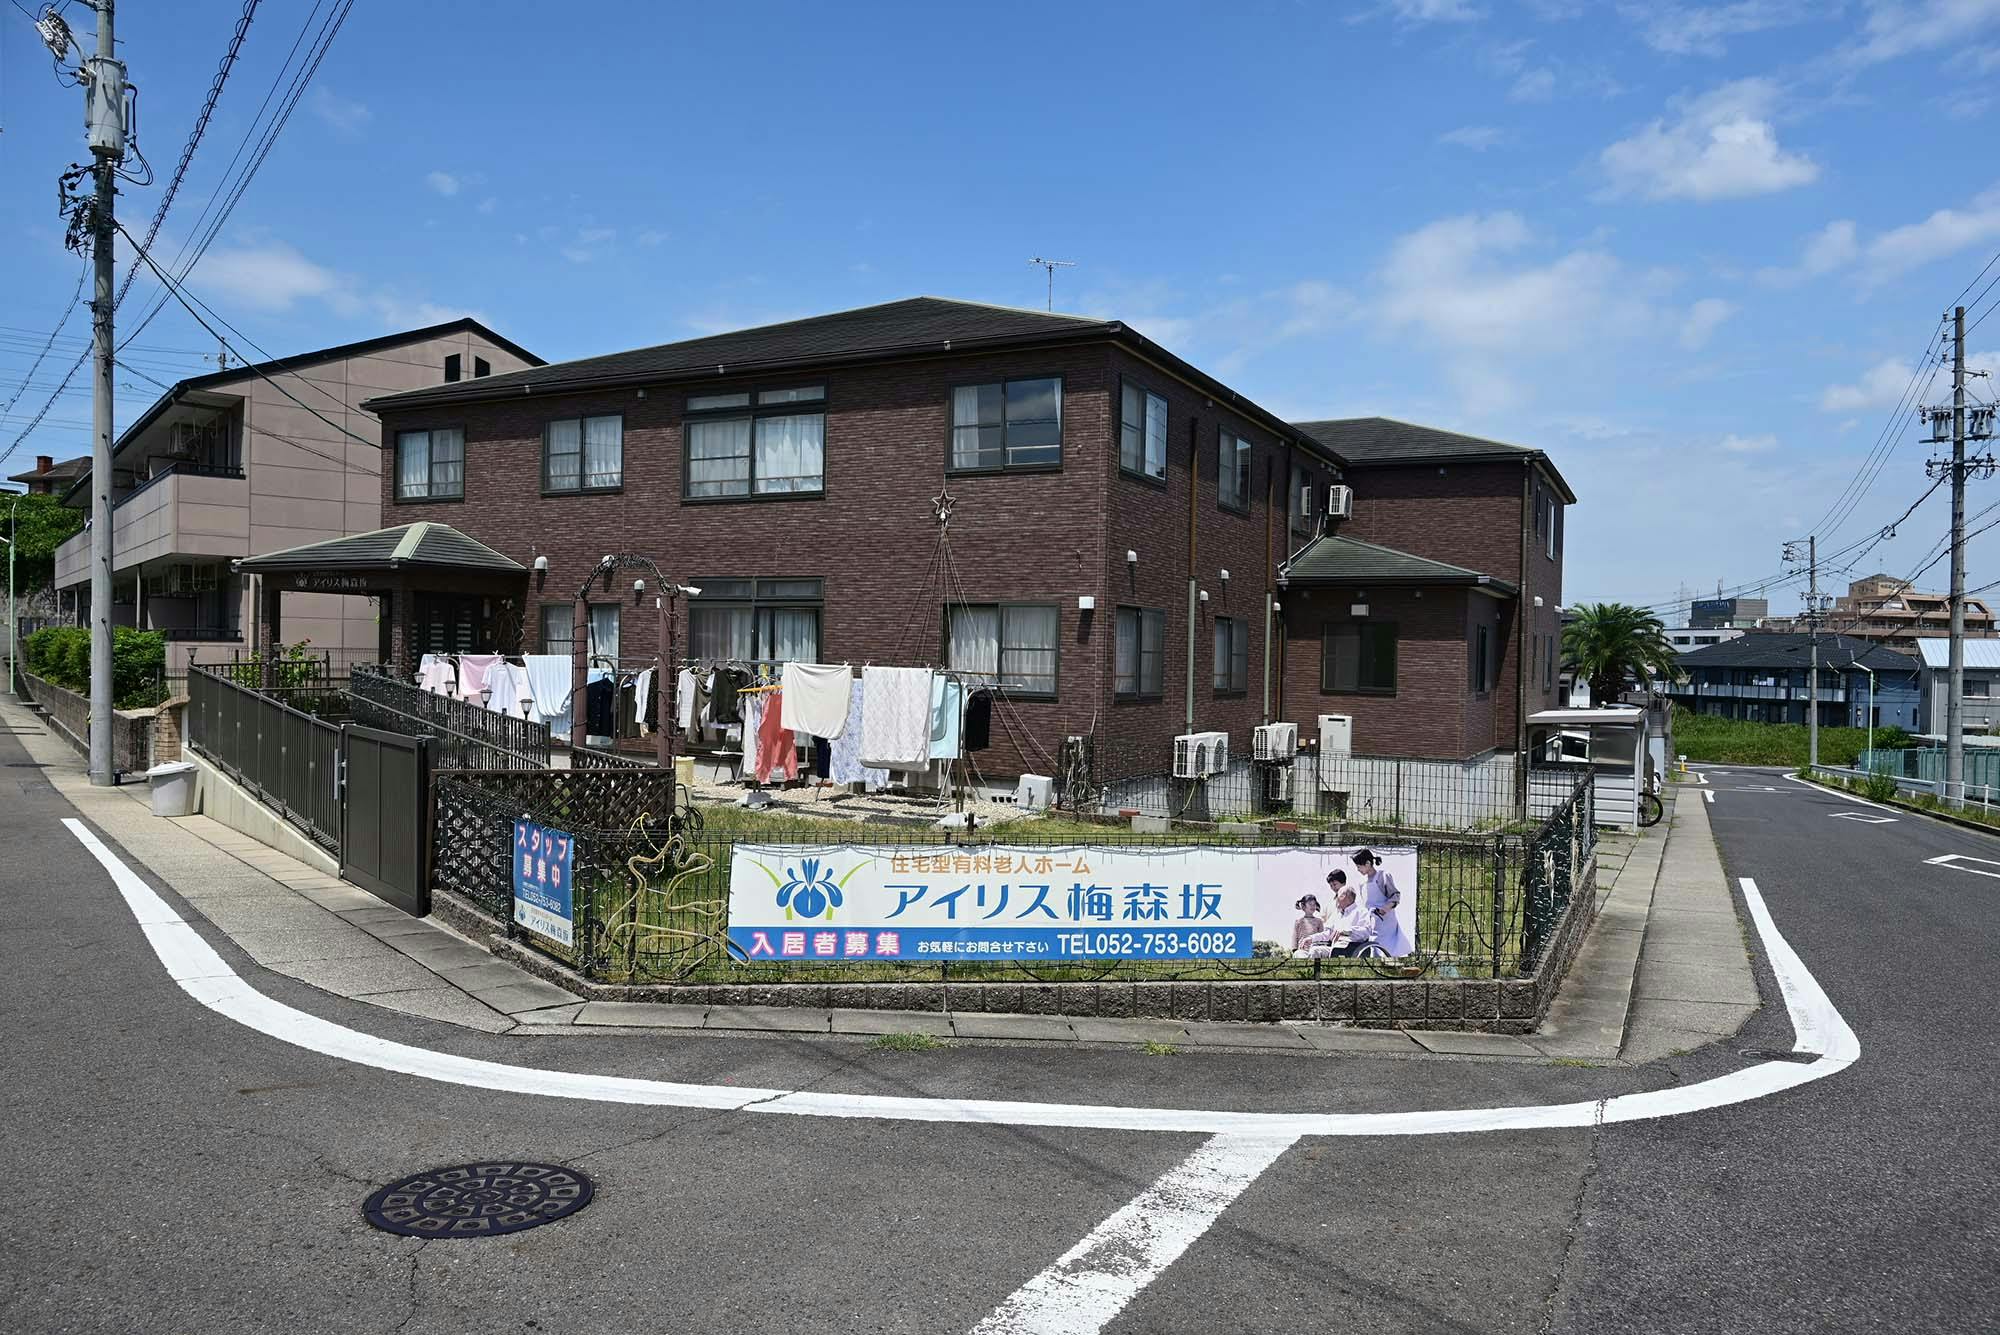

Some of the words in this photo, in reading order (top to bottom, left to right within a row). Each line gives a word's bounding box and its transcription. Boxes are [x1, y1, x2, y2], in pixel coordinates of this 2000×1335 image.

[518, 825, 567, 861] スタッフ
[523, 854, 560, 888] 募集中
[890, 855, 1091, 875] 住宅型有料老人ホーム
[884, 883, 1223, 921] アイリス梅森坂
[752, 932, 900, 956] 入居者募集
[917, 941, 1049, 953] お気軽にお問合せ下さい
[1057, 932, 1237, 955] TEL052-753-6082
